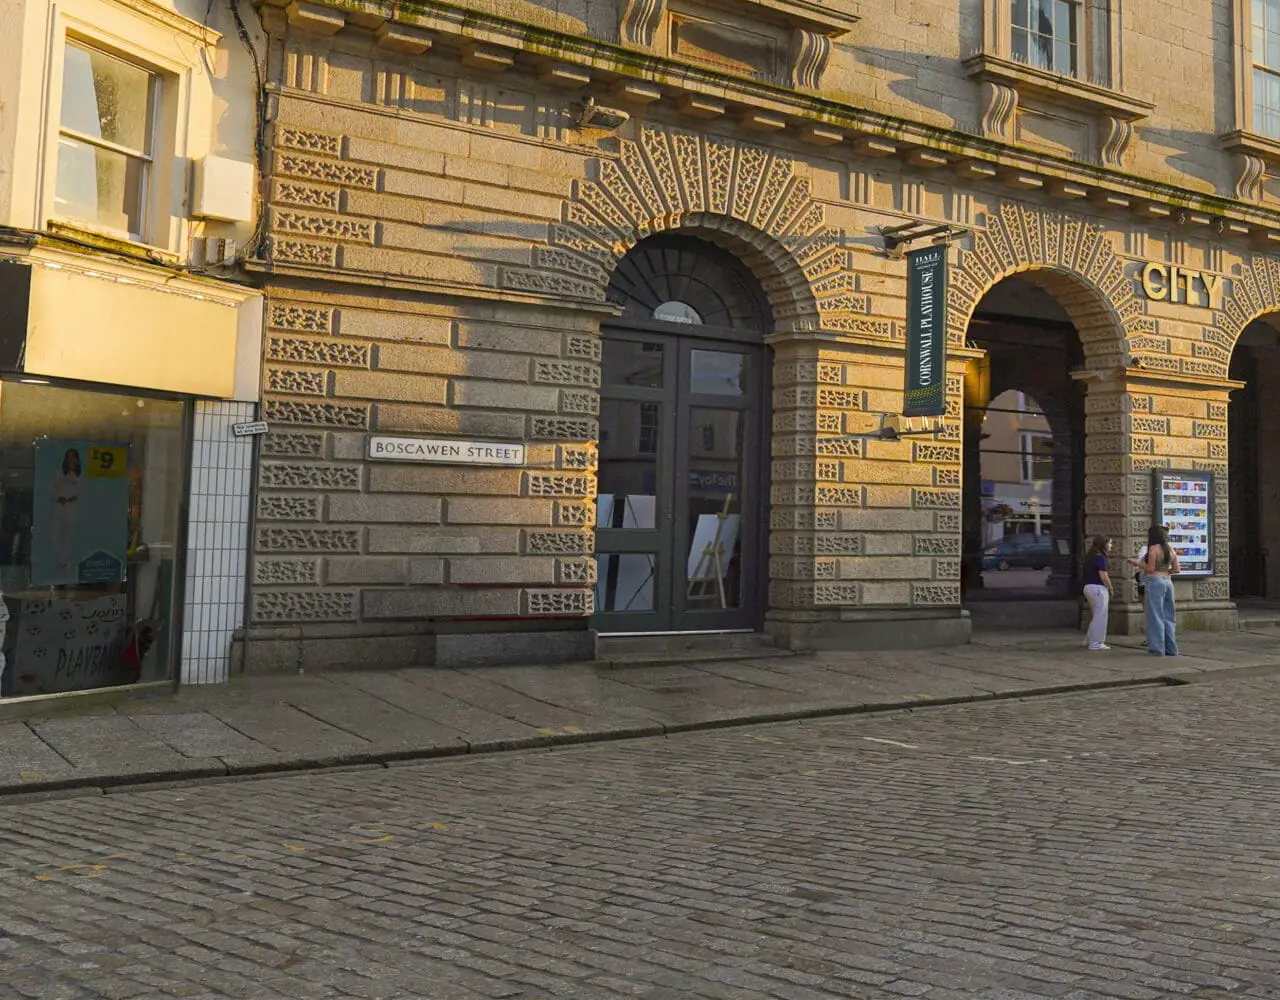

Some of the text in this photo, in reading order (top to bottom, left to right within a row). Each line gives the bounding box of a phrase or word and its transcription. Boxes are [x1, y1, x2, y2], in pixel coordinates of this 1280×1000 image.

[920, 269, 934, 329] PLAYHOUSE
[1142, 262, 1223, 309] CITY
[919, 329, 933, 386] CORNWALL
[376, 442, 520, 459] BOSCAWEN STREET
